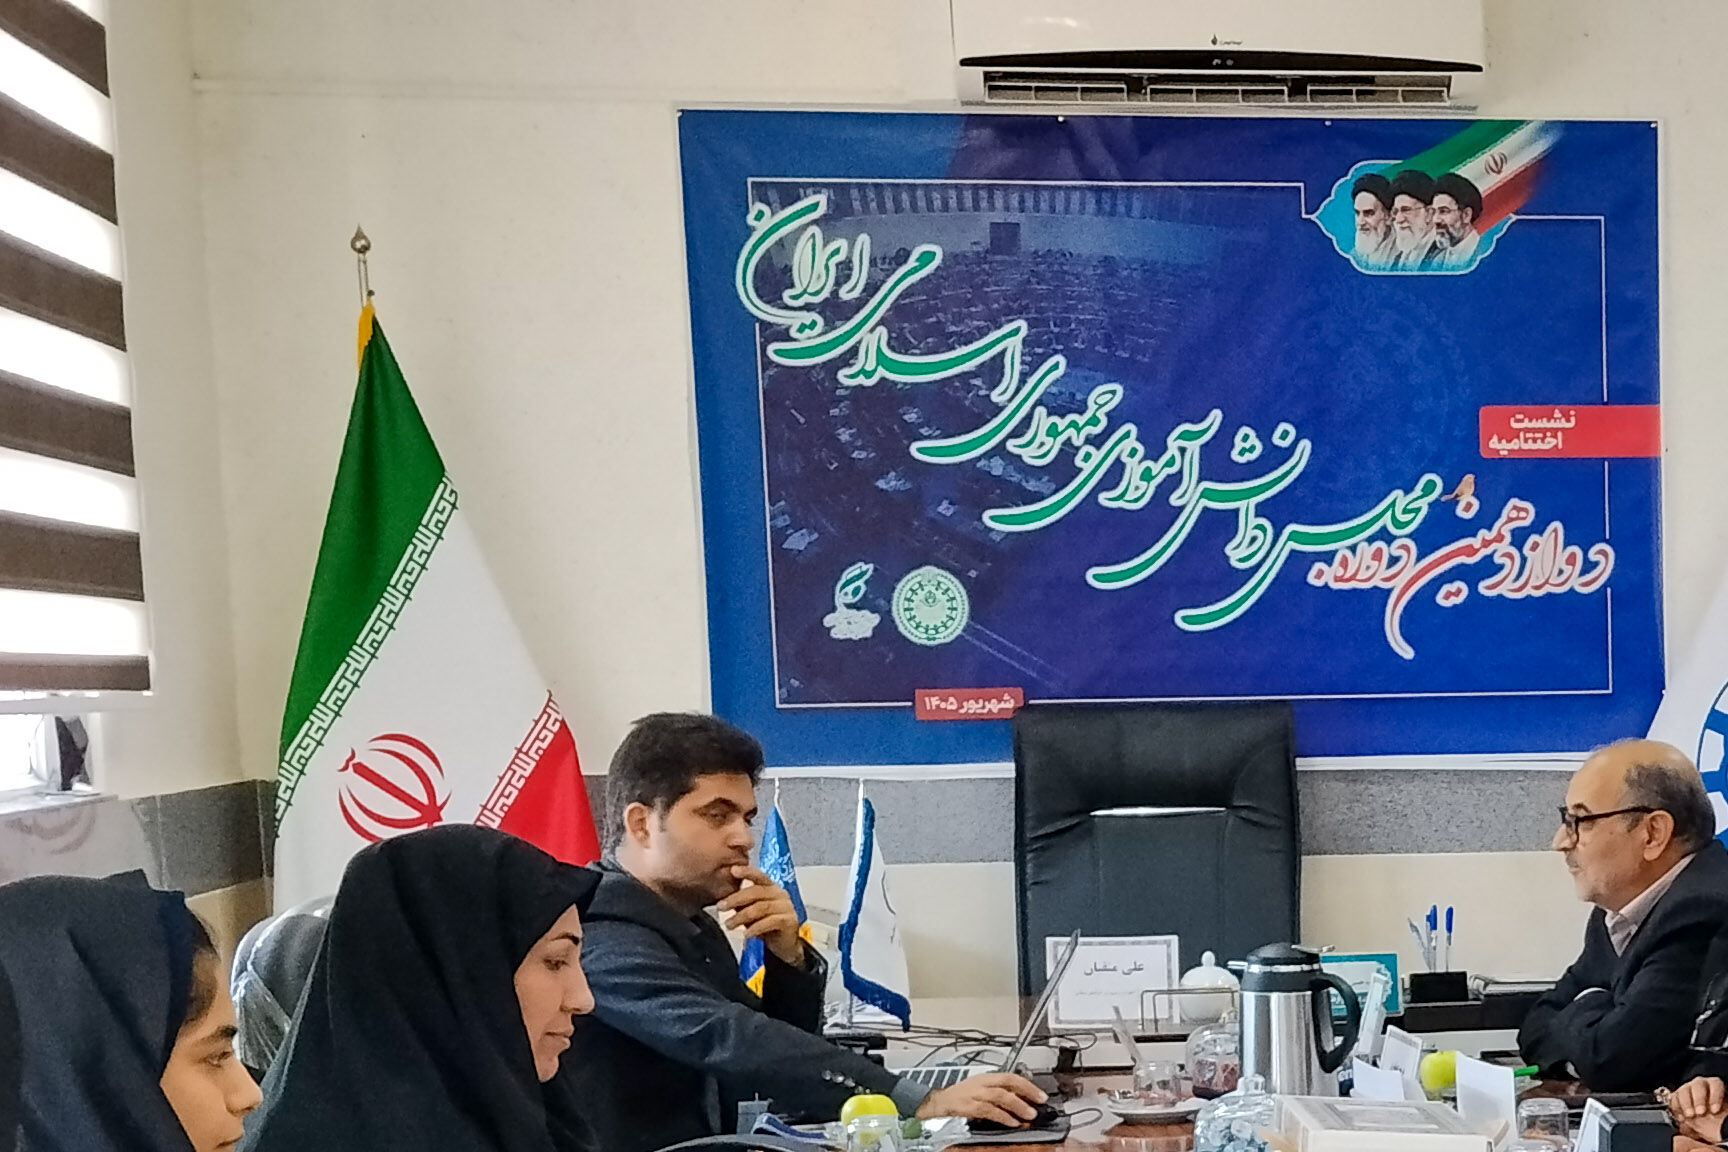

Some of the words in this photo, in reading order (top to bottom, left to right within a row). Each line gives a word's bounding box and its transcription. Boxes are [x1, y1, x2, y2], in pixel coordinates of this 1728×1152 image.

[737, 196, 870, 337] ایران
[766, 244, 1026, 402] اسلامی
[910, 355, 1123, 466] جمهوری
[1489, 431, 1563, 456] اختتامیه
[1510, 408, 1576, 429] نشست
[1174, 473, 1444, 632] مجلس
[1384, 495, 1614, 660] دوازدهمین
[958, 692, 1015, 713] شهریور
